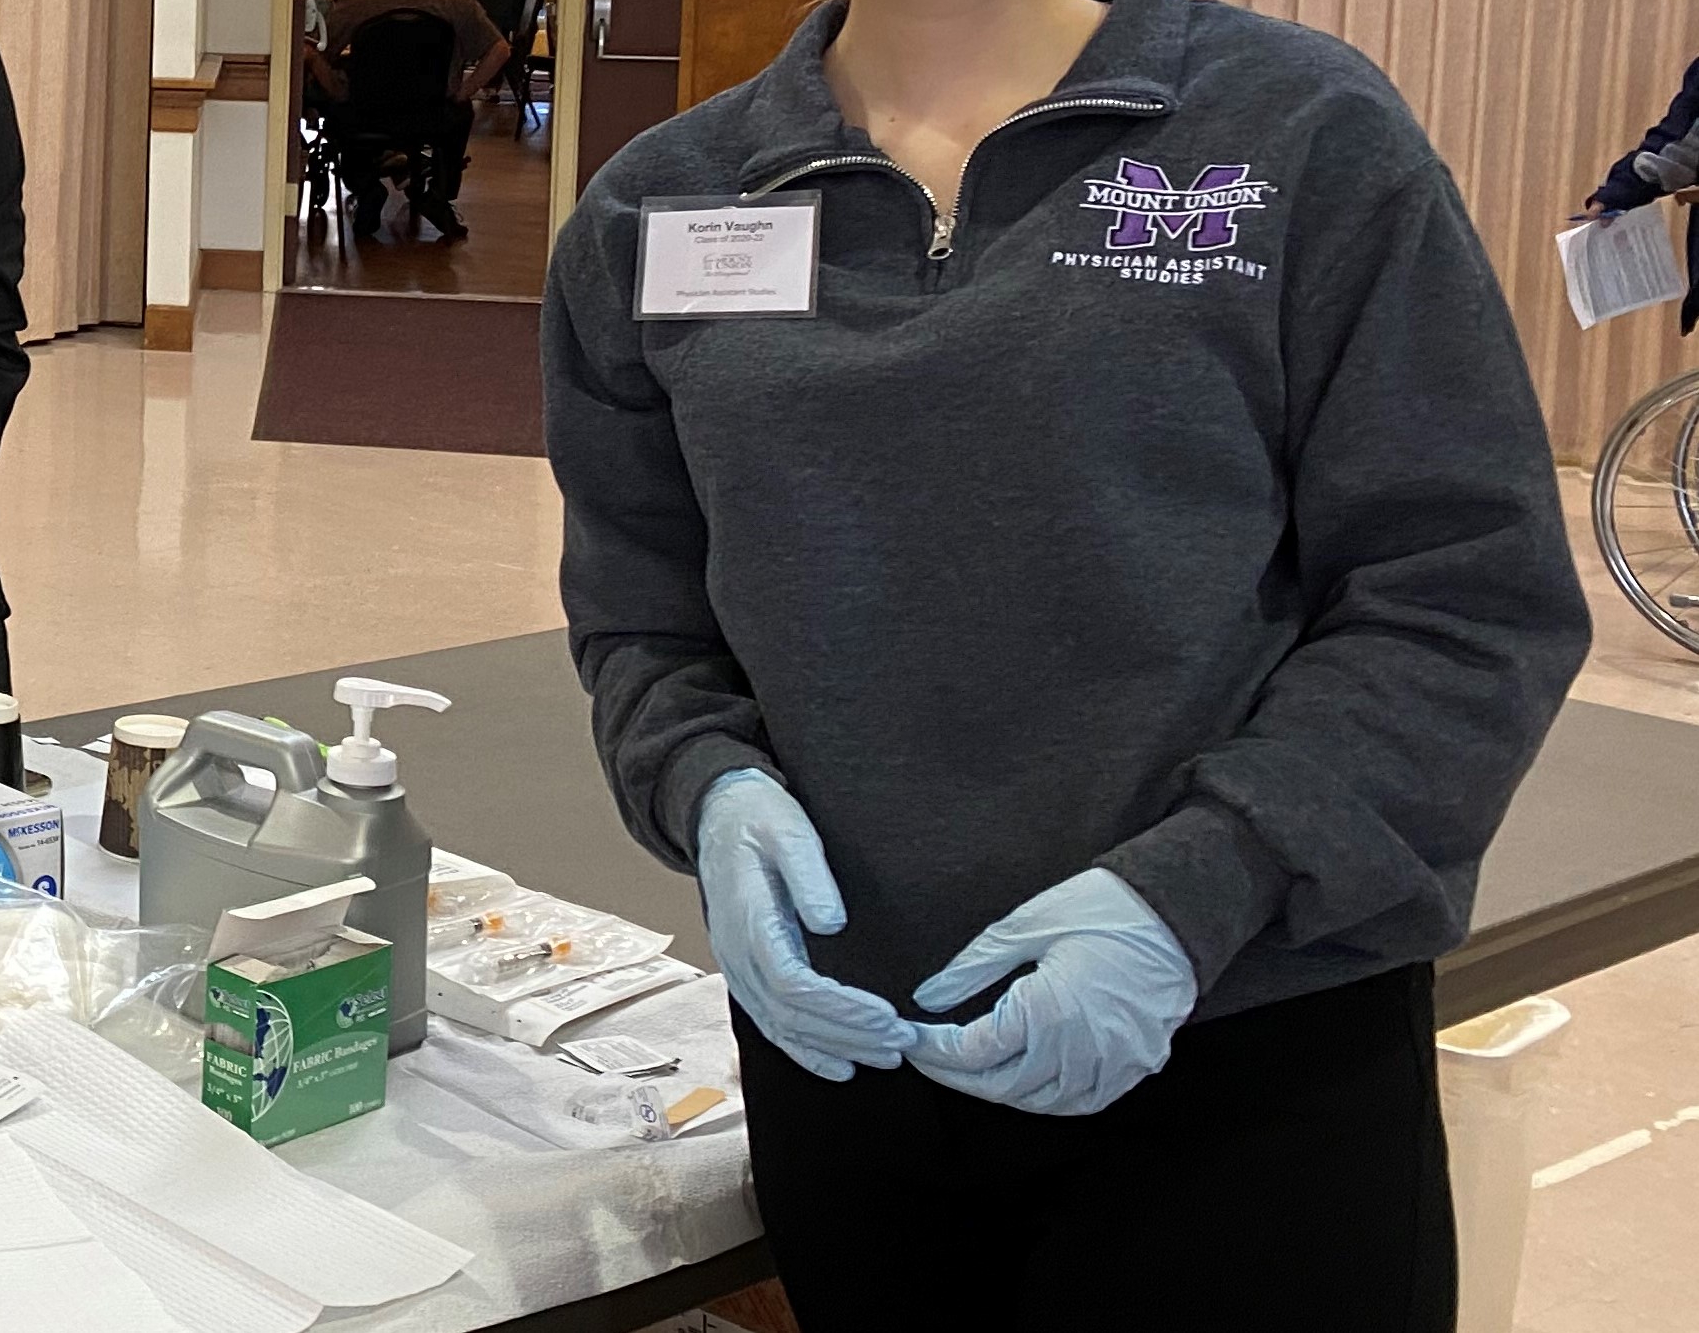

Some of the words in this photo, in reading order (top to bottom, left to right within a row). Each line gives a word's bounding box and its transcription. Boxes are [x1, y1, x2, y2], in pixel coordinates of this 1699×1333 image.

[1086, 184, 1180, 210] MOUNT
[1184, 185, 1263, 210] UNION
[687, 222, 722, 233] Korin
[724, 220, 774, 234] Vaughn
[1052, 251, 1158, 268] PHYSICIAN
[1165, 255, 1268, 281] ASSISTANT
[1119, 268, 1205, 285] STUDIES
[206, 1051, 247, 1078] FABRIC
[292, 1049, 333, 1074] FABRIC
[334, 1039, 378, 1059] Bandages
